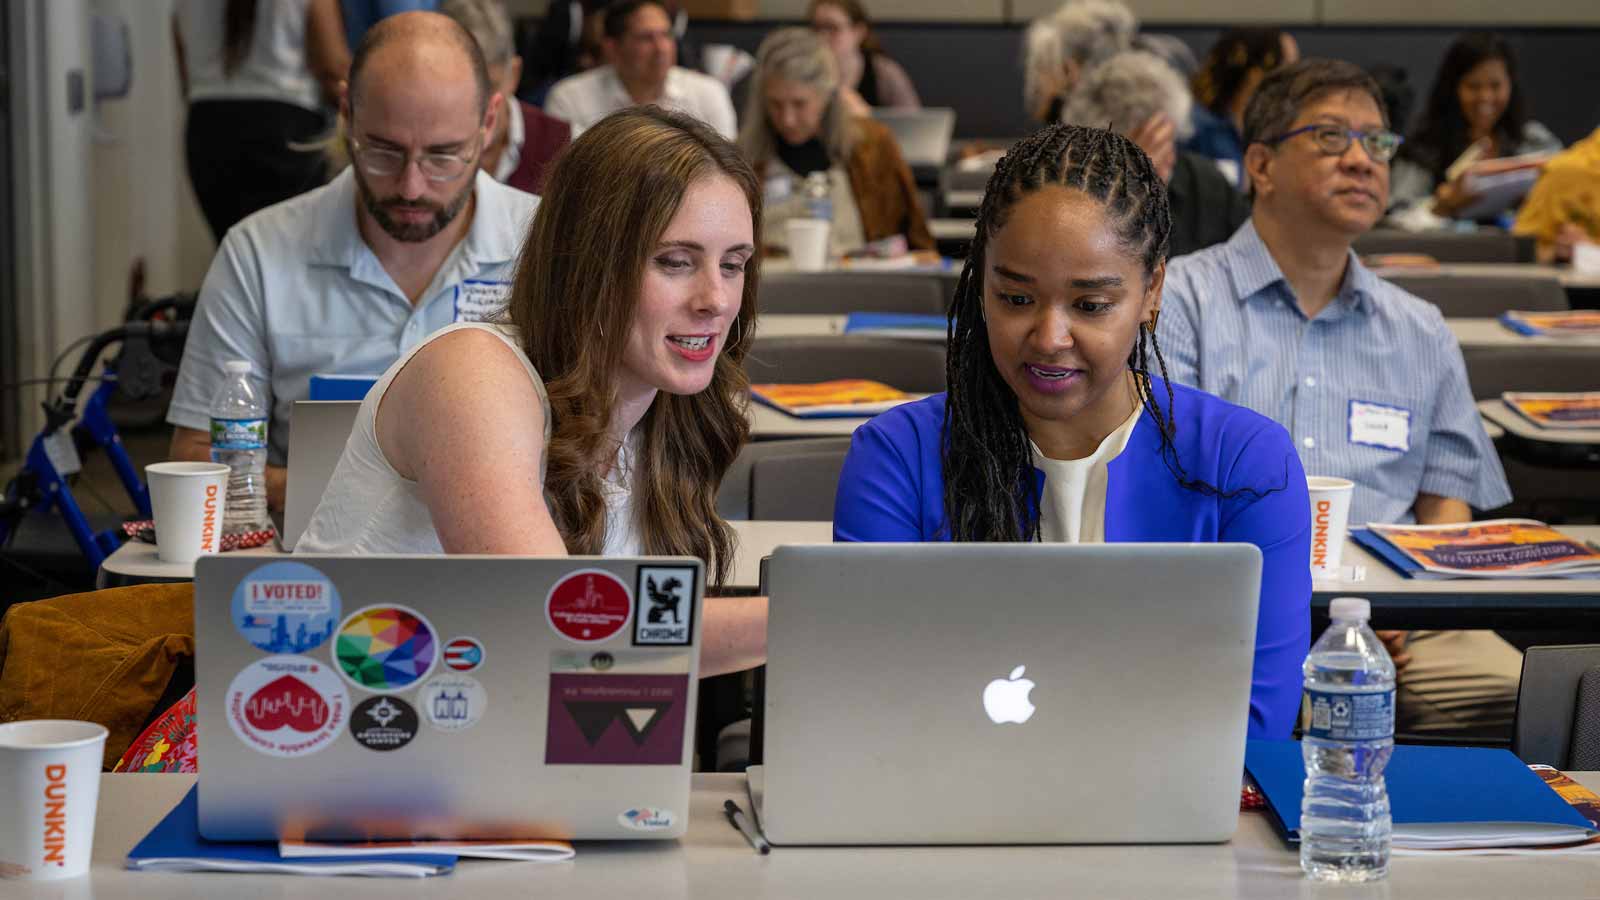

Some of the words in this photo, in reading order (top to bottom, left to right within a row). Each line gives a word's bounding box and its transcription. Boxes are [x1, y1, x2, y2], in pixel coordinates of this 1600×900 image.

[201, 484, 218, 553] DUNKIN'
[1312, 500, 1330, 569] DUNKIN'
[252, 583, 258, 599] I
[263, 583, 322, 599] VOTED!
[640, 628, 685, 641] CHROME
[44, 763, 66, 867] DUNKIN'
[642, 818, 670, 827] Voted
